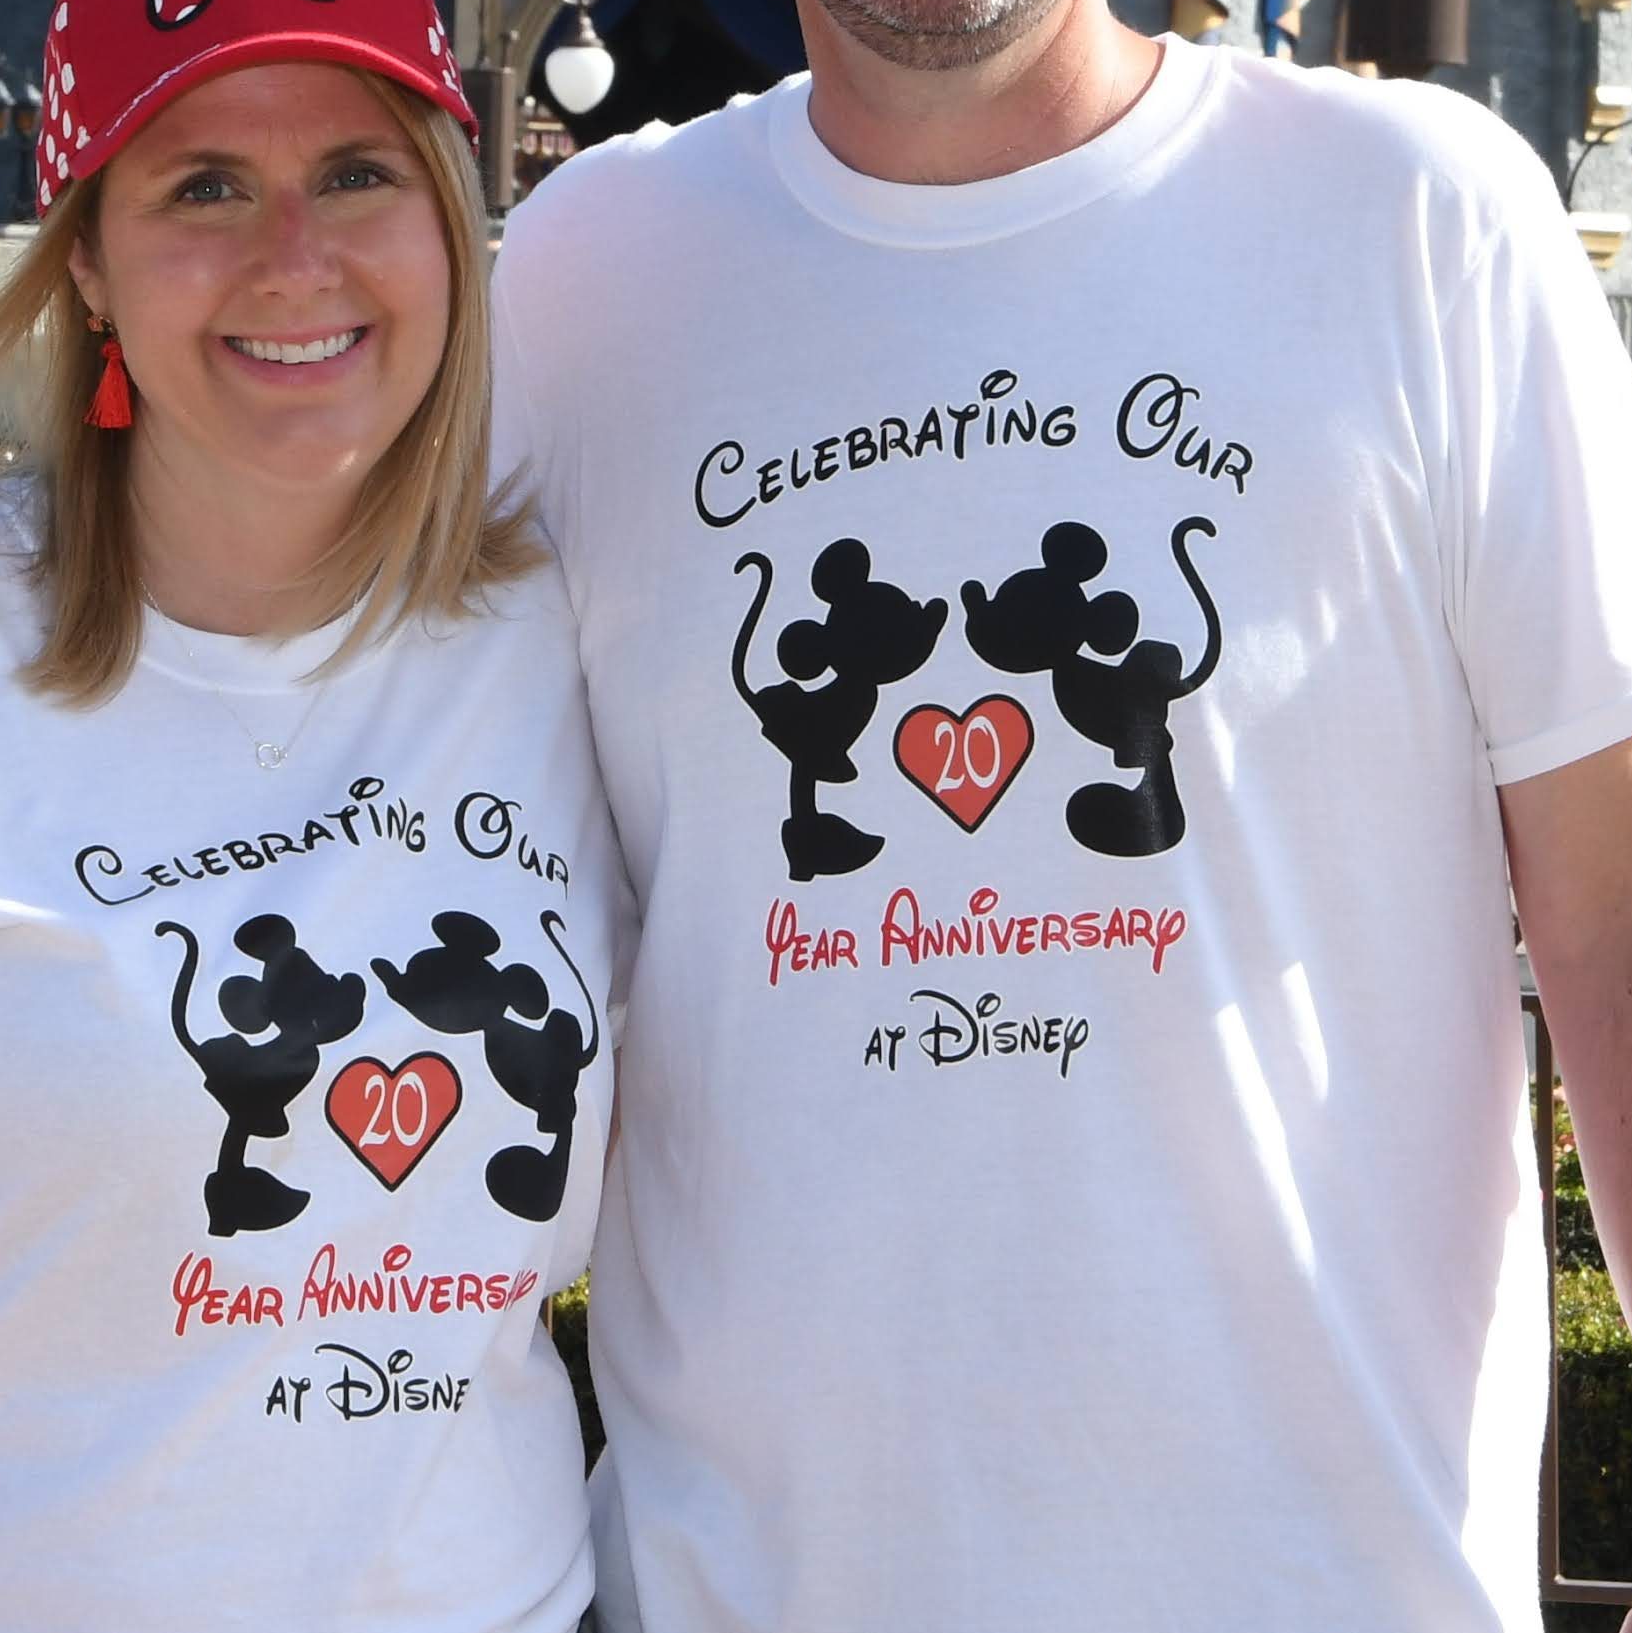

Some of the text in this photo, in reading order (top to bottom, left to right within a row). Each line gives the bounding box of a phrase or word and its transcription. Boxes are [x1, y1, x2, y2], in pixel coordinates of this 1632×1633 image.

[933, 715, 1002, 795] 20
[765, 887, 1187, 986] YEAR ANNIVERSARY
[909, 989, 1089, 1079] DISNEY
[357, 1072, 428, 1149] 20
[171, 1251, 285, 1337] YEAR
[314, 1343, 471, 1421] DISNE
